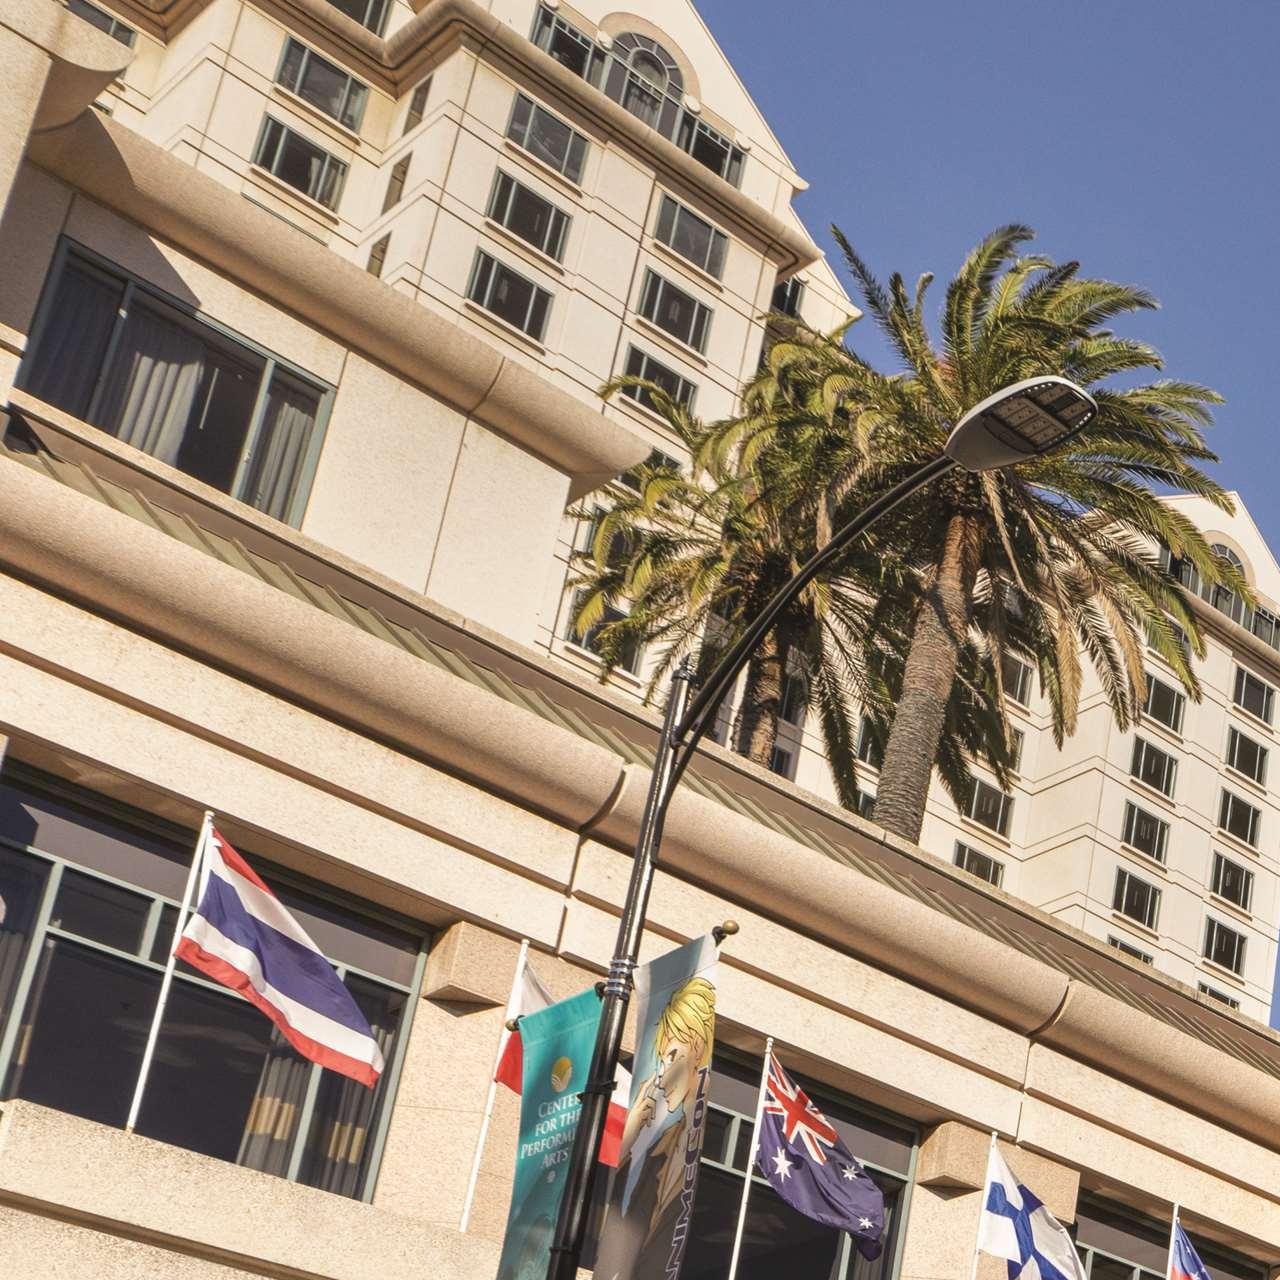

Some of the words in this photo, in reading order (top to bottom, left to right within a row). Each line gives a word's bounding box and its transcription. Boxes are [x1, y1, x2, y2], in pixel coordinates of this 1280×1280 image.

[535, 1118, 557, 1137] FOR
[520, 1128, 576, 1160] PERFORMI
[542, 1148, 569, 1168] ARTS
